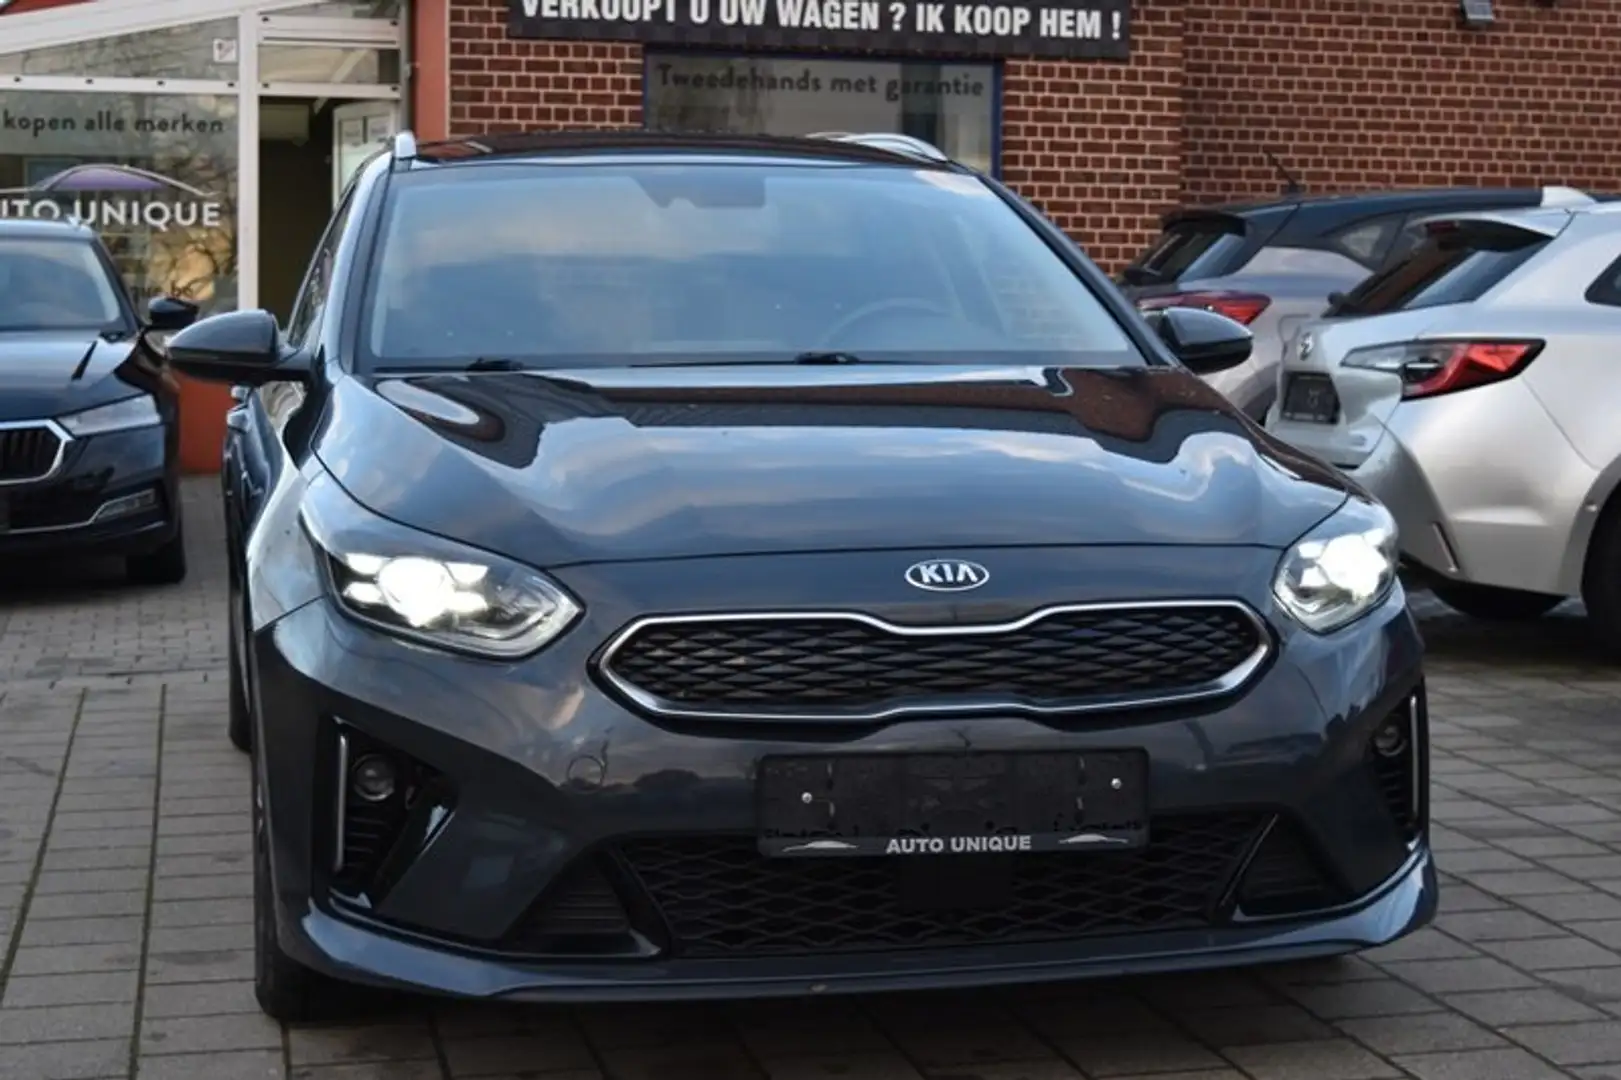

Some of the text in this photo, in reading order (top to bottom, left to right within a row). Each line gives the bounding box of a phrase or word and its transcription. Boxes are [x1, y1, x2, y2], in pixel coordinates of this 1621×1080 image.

[690, 0, 709, 24] U
[719, 0, 766, 26] UW
[776, 0, 880, 30] WAGEN
[889, 2, 906, 31] ?
[916, 3, 944, 33] IK
[954, 5, 1031, 36] KOOP
[1039, 9, 1101, 39] HEM
[1111, 11, 1121, 40] !
[657, 63, 984, 103] Tweedehands met garantie
[3, 110, 223, 137] kopen alle merken
[73, 200, 221, 231] UNIQUE
[919, 562, 979, 583] KIA
[886, 834, 1032, 854] AUTO UNIQUE
